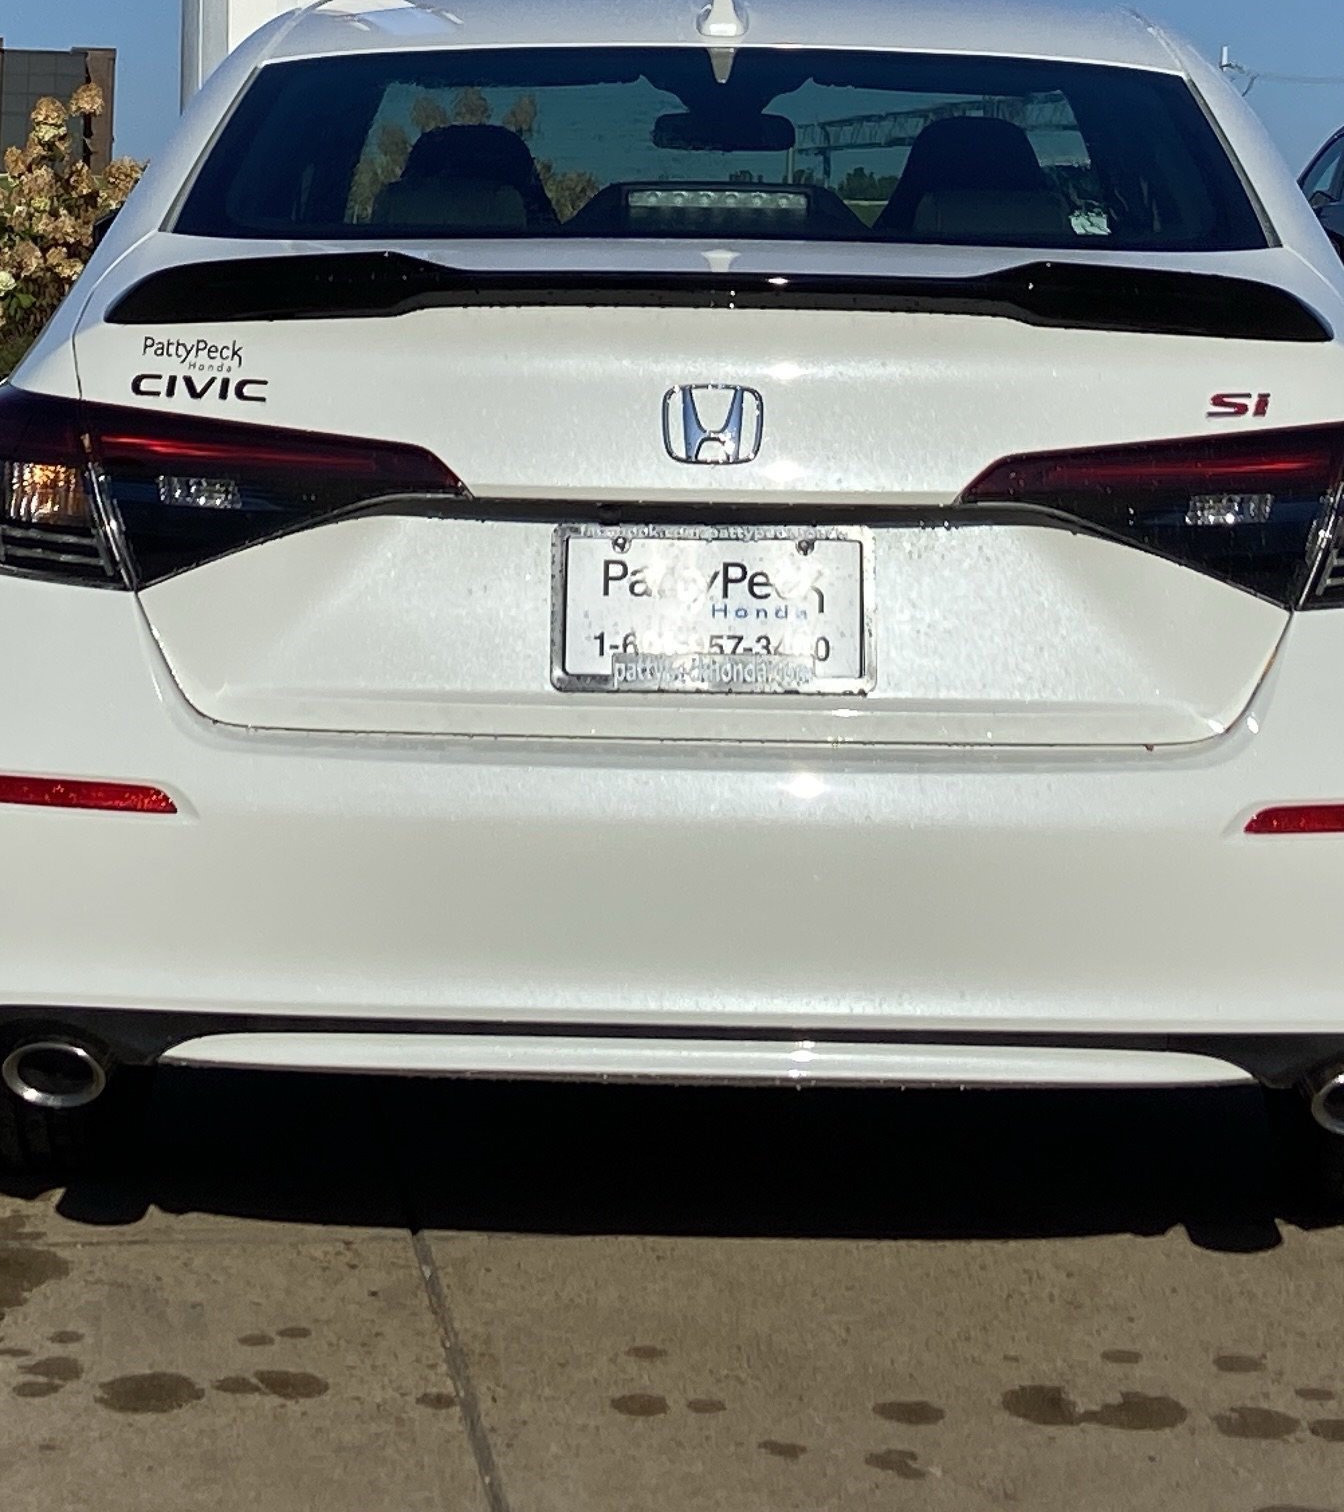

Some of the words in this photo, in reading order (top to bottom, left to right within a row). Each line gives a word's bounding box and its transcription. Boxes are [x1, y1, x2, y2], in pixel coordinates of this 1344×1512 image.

[142, 336, 244, 368] PattyPeck
[187, 361, 233, 373] Honda
[131, 373, 269, 403] CIVIC
